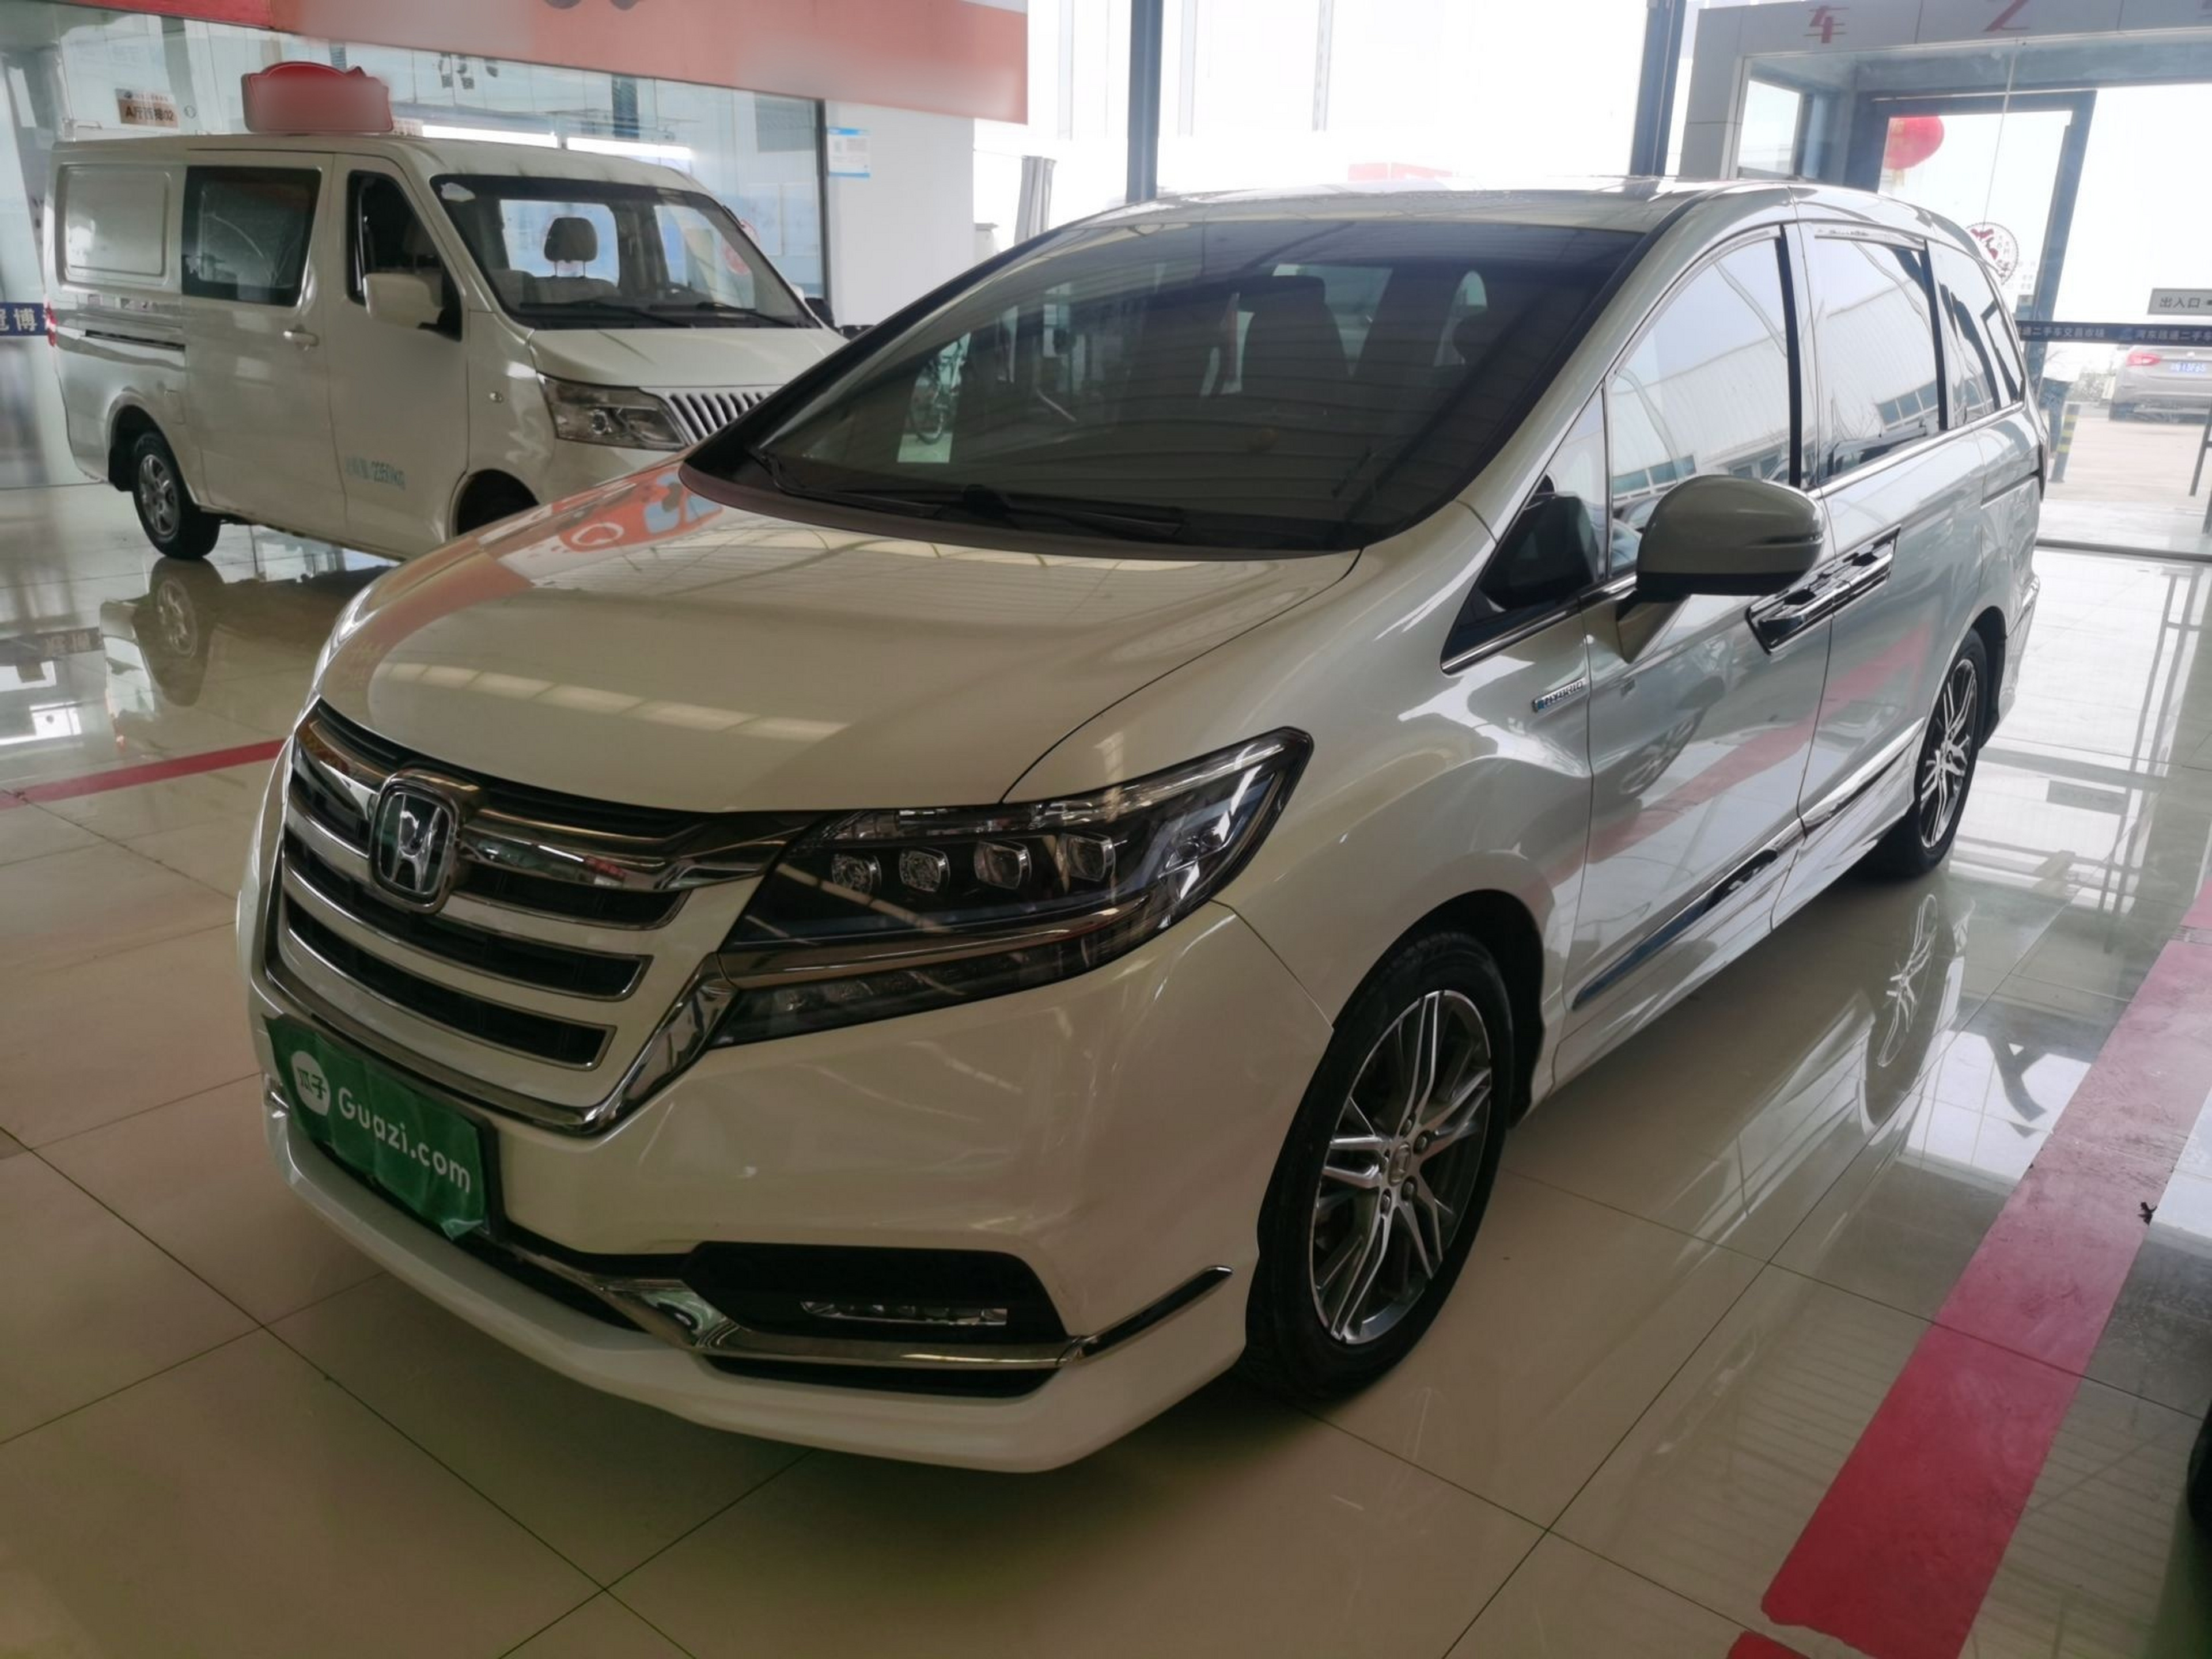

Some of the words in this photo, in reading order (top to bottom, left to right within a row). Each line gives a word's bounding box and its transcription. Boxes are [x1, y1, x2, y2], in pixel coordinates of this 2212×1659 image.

[2159, 297, 2200, 308] 出入口
[1544, 680, 1583, 706] HYBRID
[338, 1086, 471, 1194] Guazi.com
